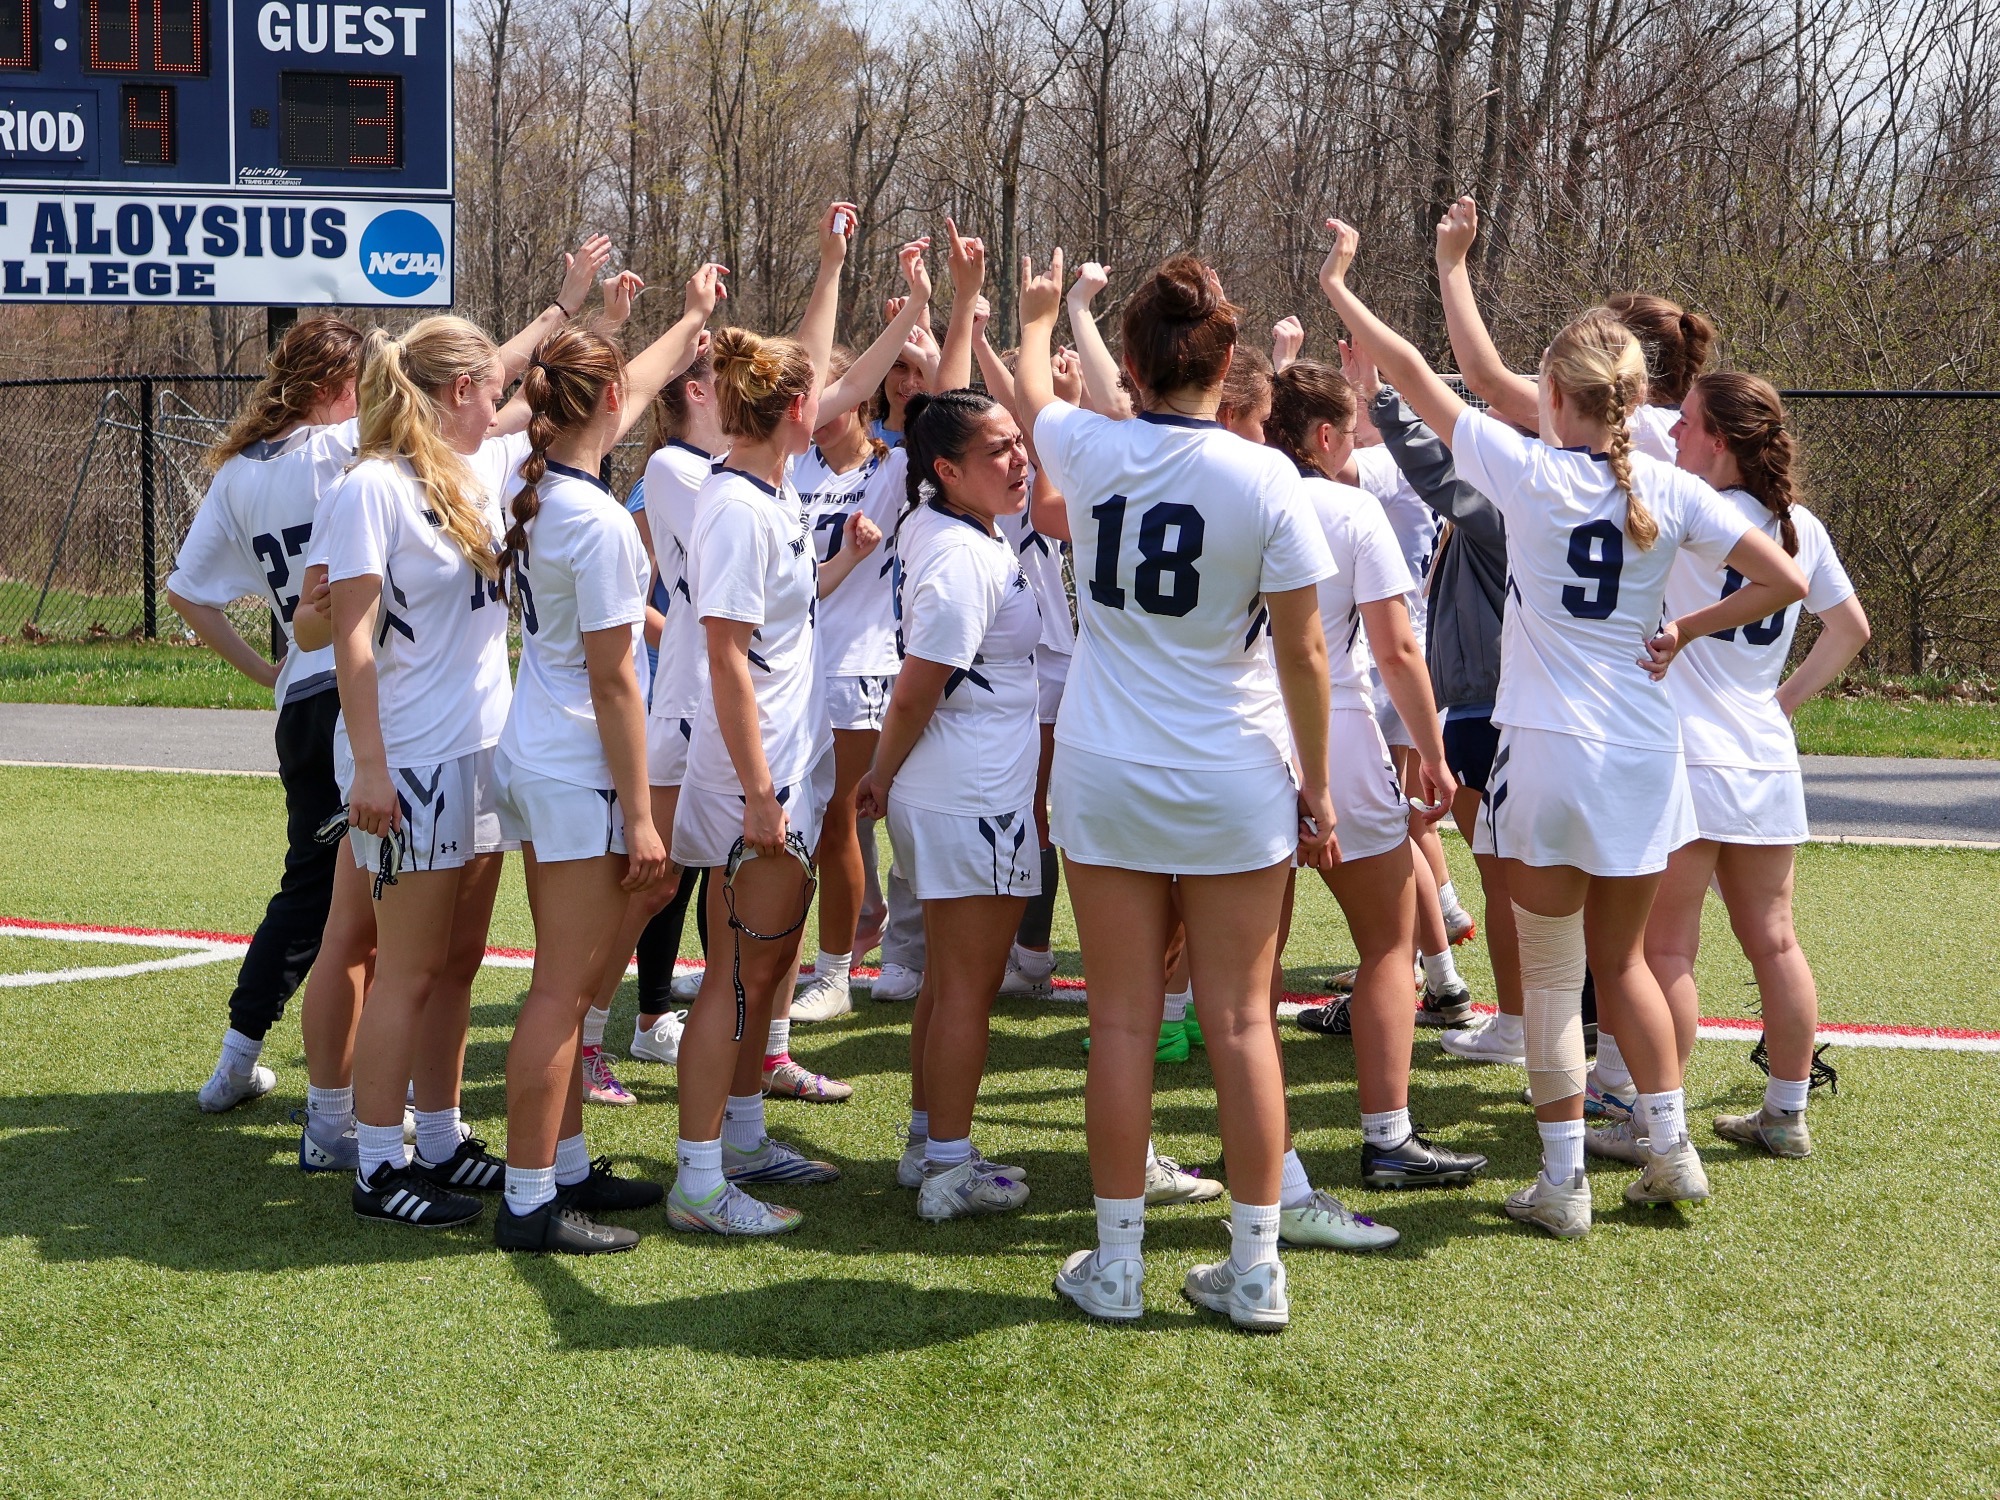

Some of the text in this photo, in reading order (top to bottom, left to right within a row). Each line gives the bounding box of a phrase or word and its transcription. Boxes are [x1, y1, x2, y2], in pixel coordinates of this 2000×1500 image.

[257, 1, 426, 56] GUEST
[128, 90, 168, 160] 4
[348, 79, 394, 164] 3
[30, 201, 348, 259] ALOYSIUS
[367, 251, 442, 276] NCAA
[1089, 494, 1205, 617] 18
[1561, 519, 1624, 620] 9
